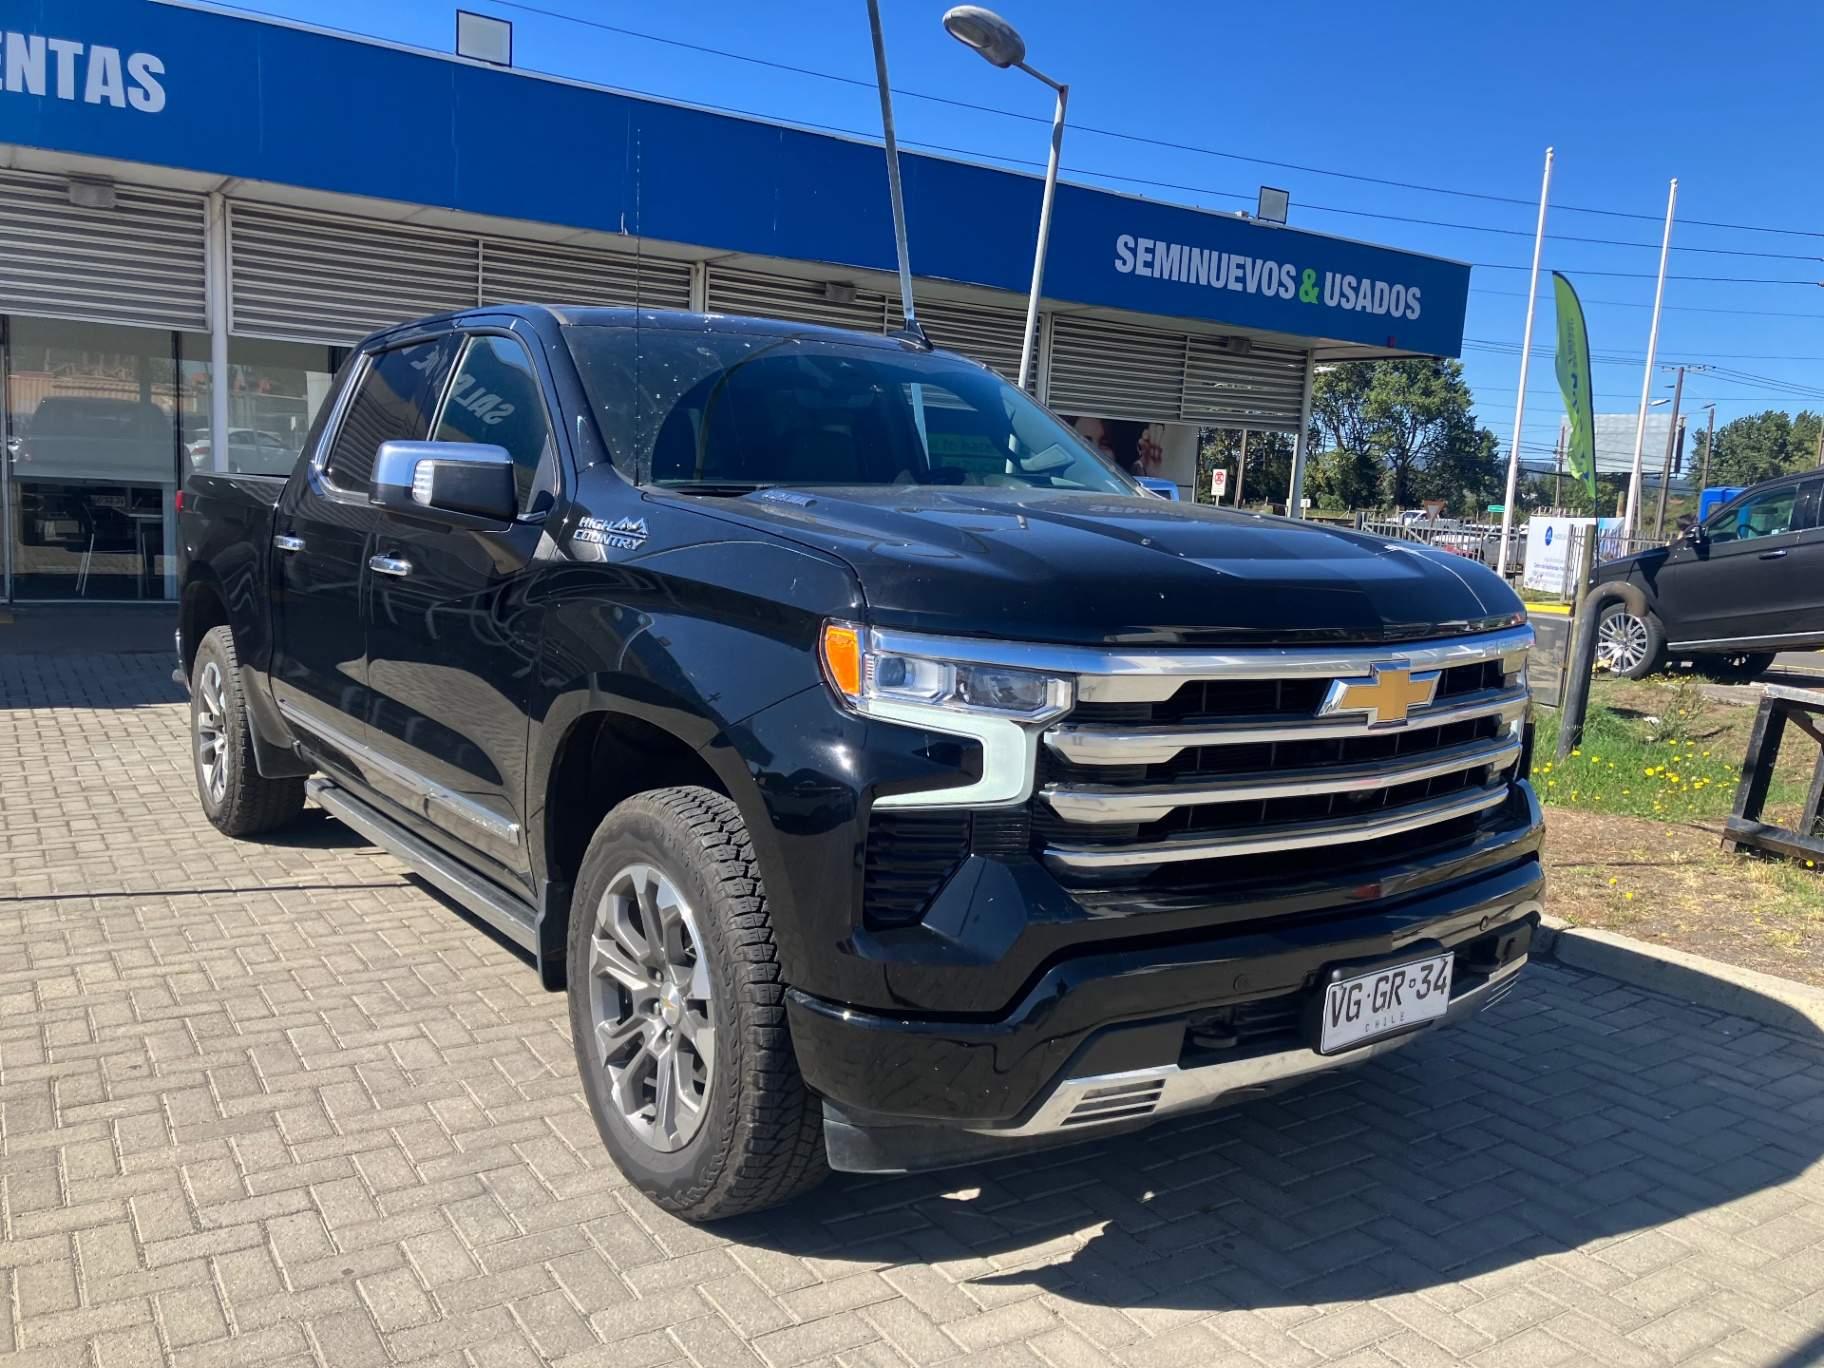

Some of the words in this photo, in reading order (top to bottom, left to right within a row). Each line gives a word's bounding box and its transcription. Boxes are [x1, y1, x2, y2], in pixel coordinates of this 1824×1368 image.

[0, 31, 166, 113] NTAS
[1114, 234, 1296, 299] SEMINUEVOS
[1299, 268, 1319, 304] &
[1323, 271, 1421, 320] USADOS
[578, 516, 613, 531] HIGH
[573, 529, 647, 551] COUNTRY
[1365, 1014, 1405, 1032] CHILE
